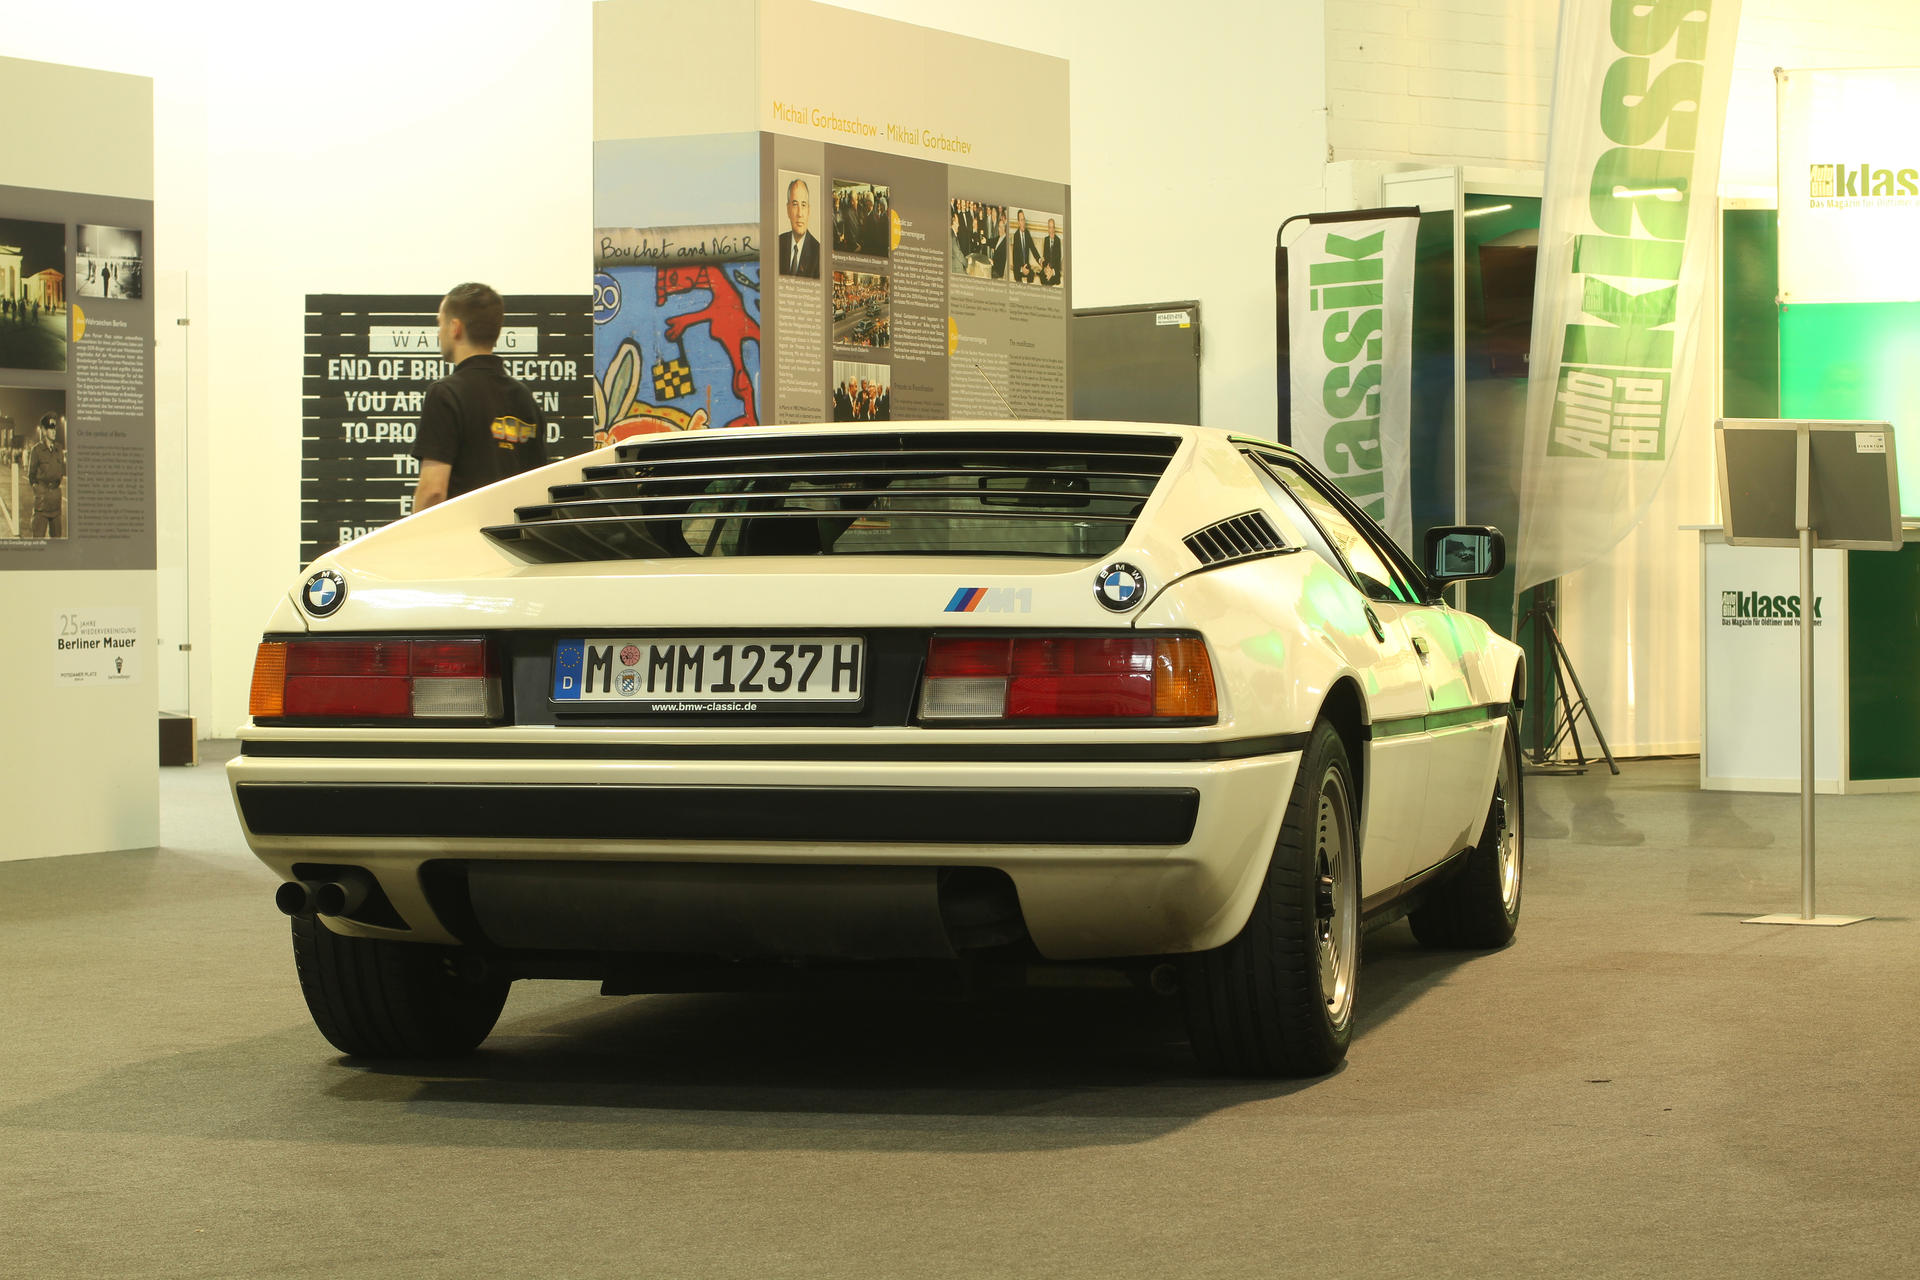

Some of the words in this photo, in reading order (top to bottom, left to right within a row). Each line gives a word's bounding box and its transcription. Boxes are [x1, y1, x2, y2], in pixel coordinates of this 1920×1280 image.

[773, 101, 808, 124] Michail
[811, 109, 877, 136] Gorbatschow
[887, 123, 919, 145] Mikhail
[922, 130, 971, 154] Gorbachev
[677, 241, 708, 258] and
[328, 359, 371, 381] END
[378, 359, 405, 381] OF
[410, 359, 456, 381] BRIT
[503, 359, 577, 381] SECTOR
[343, 391, 387, 412] YOU
[392, 391, 427, 412] AR
[1554, 371, 1613, 459] Auto
[1610, 376, 1664, 453] Bild
[342, 422, 369, 444] TO
[1737, 591, 1822, 618] klassk
[60, 614, 79, 636] 25
[1732, 618, 1752, 627] Magazin
[1761, 618, 1783, 626] Oldtimer
[1784, 618, 1793, 626] und
[58, 638, 101, 650] Berliner
[103, 637, 136, 649] Mauer
[562, 676, 574, 690] D
[585, 645, 614, 693] M
[651, 702, 757, 712] www.bmw-classic.de
